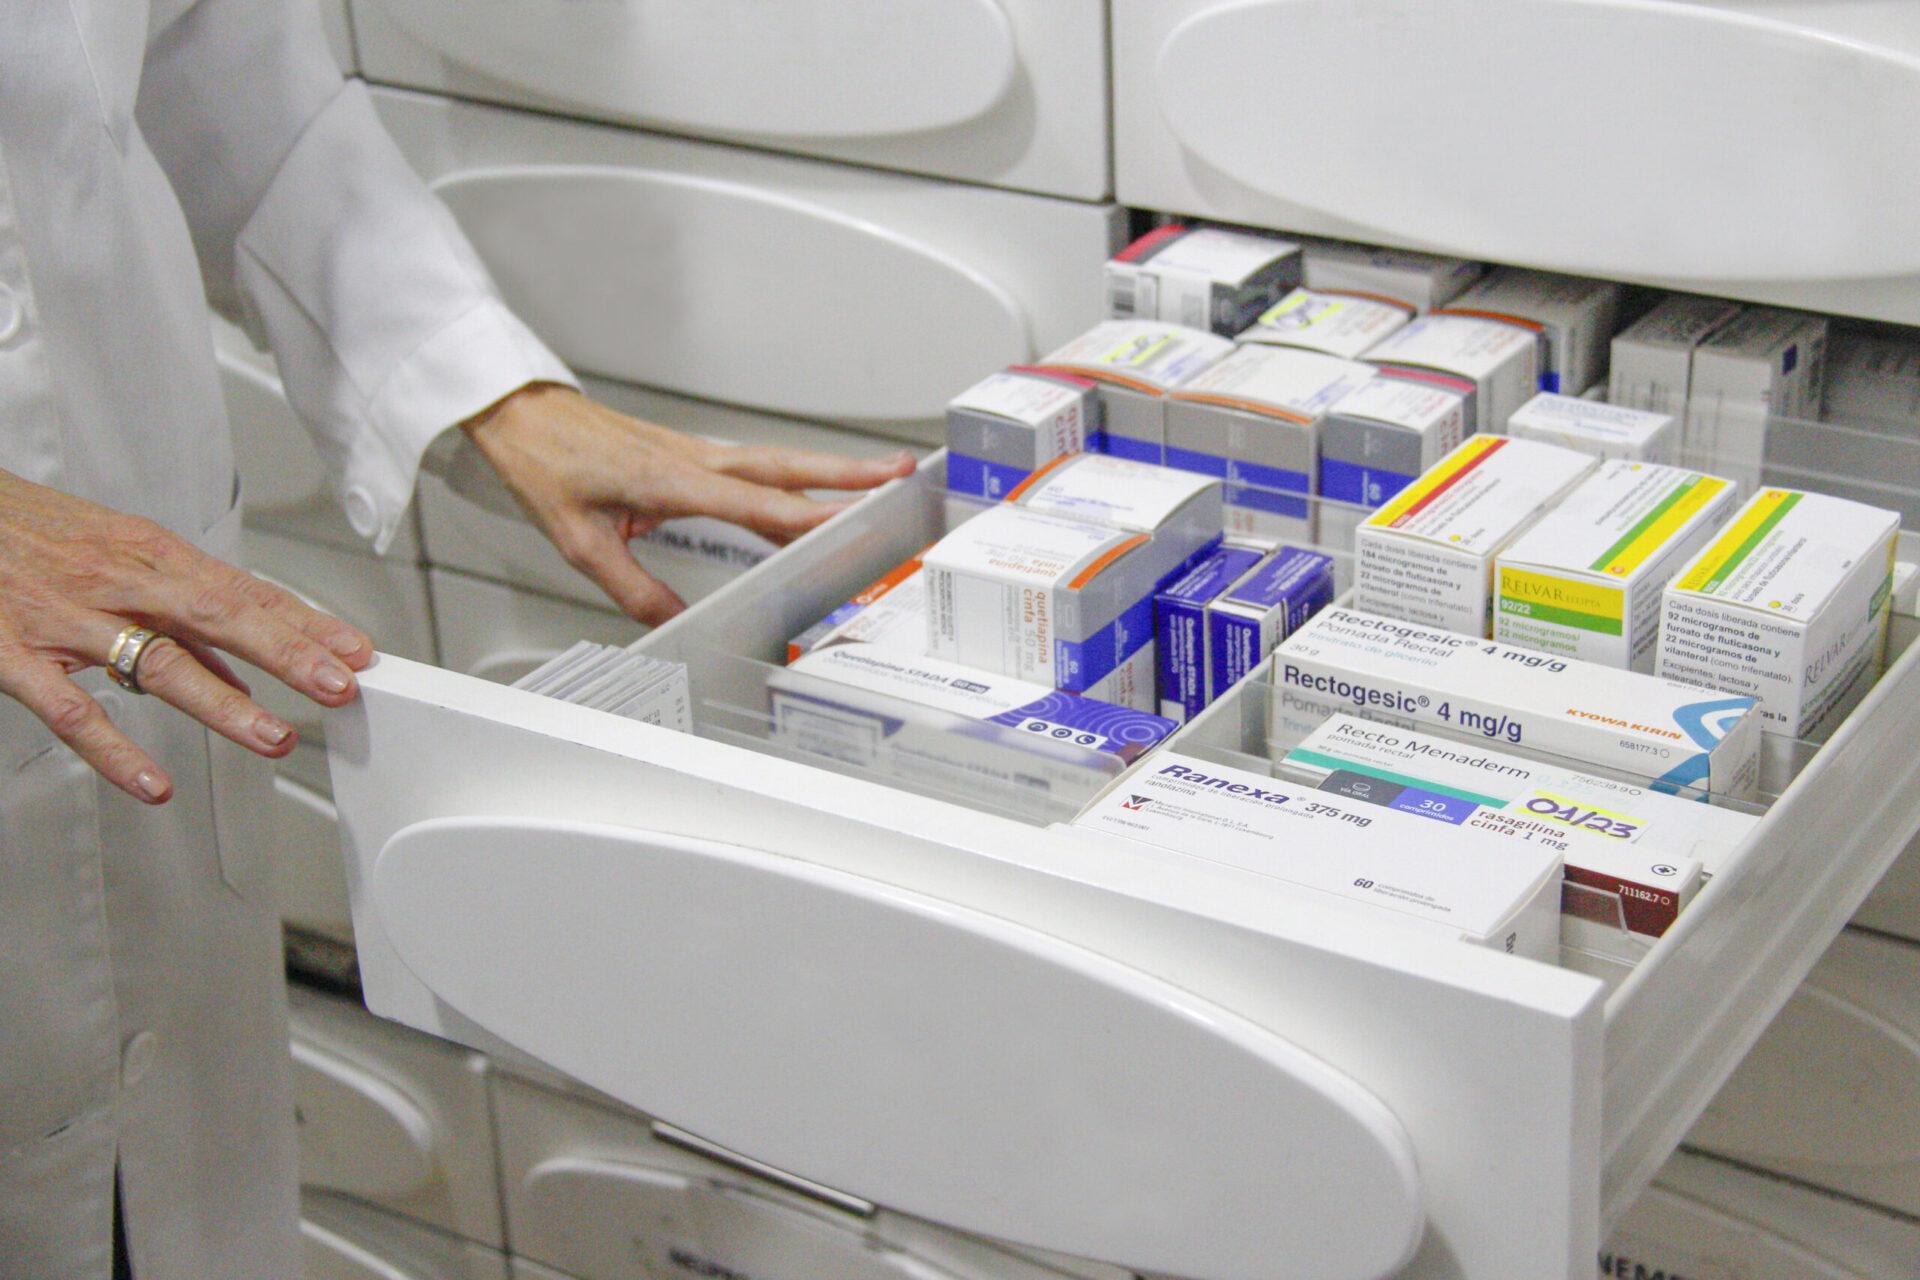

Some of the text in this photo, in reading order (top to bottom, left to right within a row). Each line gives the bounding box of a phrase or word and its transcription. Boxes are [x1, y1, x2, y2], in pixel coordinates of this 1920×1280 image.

[1361, 560, 1461, 591] furoato de fluticasona y
[1378, 555, 1434, 573] microgramos
[1437, 567, 1447, 575] de
[1361, 571, 1442, 596] 22 microgramos de
[1502, 576, 1562, 600] RELVAR
[1024, 588, 1034, 623] cinfa
[1669, 600, 1800, 638] Cada dosis liberada contiene
[1024, 627, 1035, 646] 50
[1035, 591, 1048, 663] quetiapina
[1667, 611, 1760, 640] 92 microgramos de
[1290, 643, 1308, 653] 30
[1317, 621, 1389, 644] Pomada
[1394, 638, 1453, 659] Rectal
[1512, 632, 1577, 652] microgramos
[1665, 633, 1757, 663] 22 microgramos de
[1667, 622, 1780, 658] furoato de fluticasona y
[1481, 646, 1498, 655] 4
[1502, 651, 1568, 673] mg/g
[1664, 646, 1708, 663] vilanterol
[1710, 657, 1739, 671] (como
[905, 669, 950, 684] STADA
[1186, 665, 1196, 695] STADA
[1662, 658, 1715, 679] Excipientes:
[1719, 673, 1751, 688] lactosa
[1753, 683, 1759, 691] y
[1437, 703, 1451, 721] 4
[1460, 710, 1522, 742] mg/g
[1566, 708, 1683, 741] KYOWA KIRIN
[1327, 734, 1415, 760] pomada rectal
[1336, 723, 1399, 746] Recto
[1405, 741, 1530, 779] Menaderm
[1145, 779, 1196, 797] ranolazina
[1151, 774, 1207, 792] comprimidos
[1265, 804, 1314, 819] prolongada
[1305, 803, 1339, 818] 375
[1341, 811, 1374, 829] mg
[1399, 803, 1455, 821] comprimidos
[1419, 799, 1446, 812] 30
[1526, 798, 1638, 838] 01/23
[1470, 818, 1570, 851] cinfa 1 mg
[1478, 810, 1566, 838] rasagilina
[1353, 878, 1374, 889] 60
